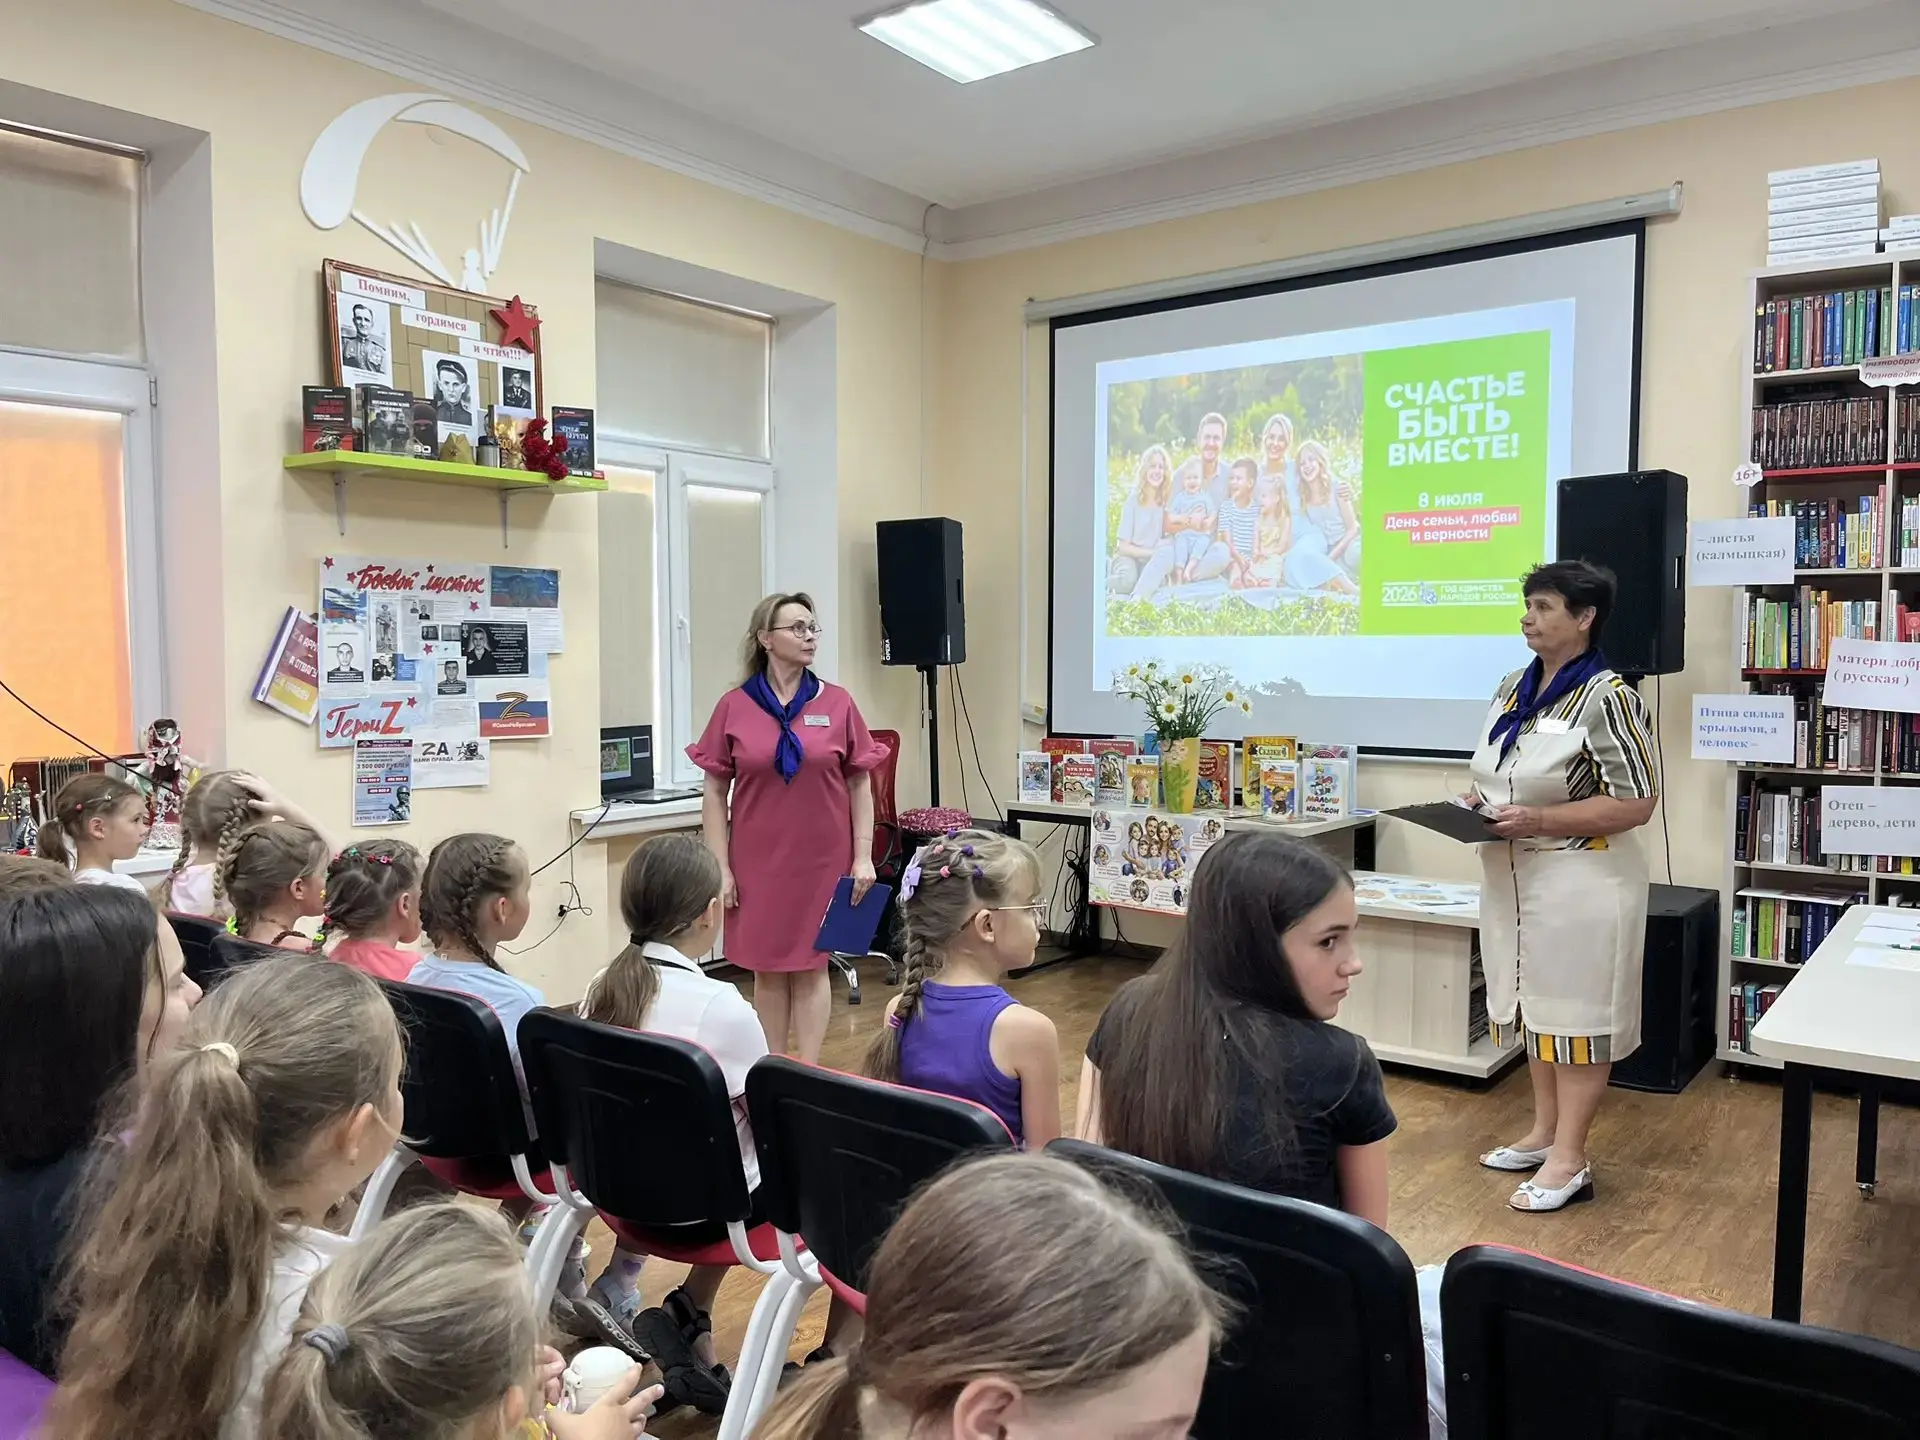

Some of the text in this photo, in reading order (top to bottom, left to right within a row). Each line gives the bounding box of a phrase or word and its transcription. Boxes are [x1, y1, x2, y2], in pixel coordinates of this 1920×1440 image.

[358, 278, 411, 303] Помним,
[415, 313, 467, 332] гордимся
[474, 344, 521, 360] и чтим!!!
[1384, 370, 1526, 408] СЧАСТЬЕ
[1398, 401, 1511, 440] БЫТЬ
[1388, 433, 1519, 467] ВМЕСТЕ!
[1735, 469, 1759, 481] 16+
[1418, 492, 1483, 508] 8 июля
[1385, 509, 1517, 530] День семьи, любви
[1412, 529, 1488, 542] и верности
[1707, 534, 1755, 544] листья
[1696, 548, 1786, 562] (калмыцкая)
[357, 564, 485, 593] Боевой листок
[1381, 586, 1418, 602] 2026
[1837, 655, 1887, 668] матери
[1843, 672, 1900, 684] русская
[1700, 707, 1785, 719] Птица сильна
[1699, 724, 1767, 734] крыльями,
[1699, 739, 1749, 748] человек
[1828, 800, 1865, 811] Отец
[1828, 819, 1916, 830] дерево, дети
